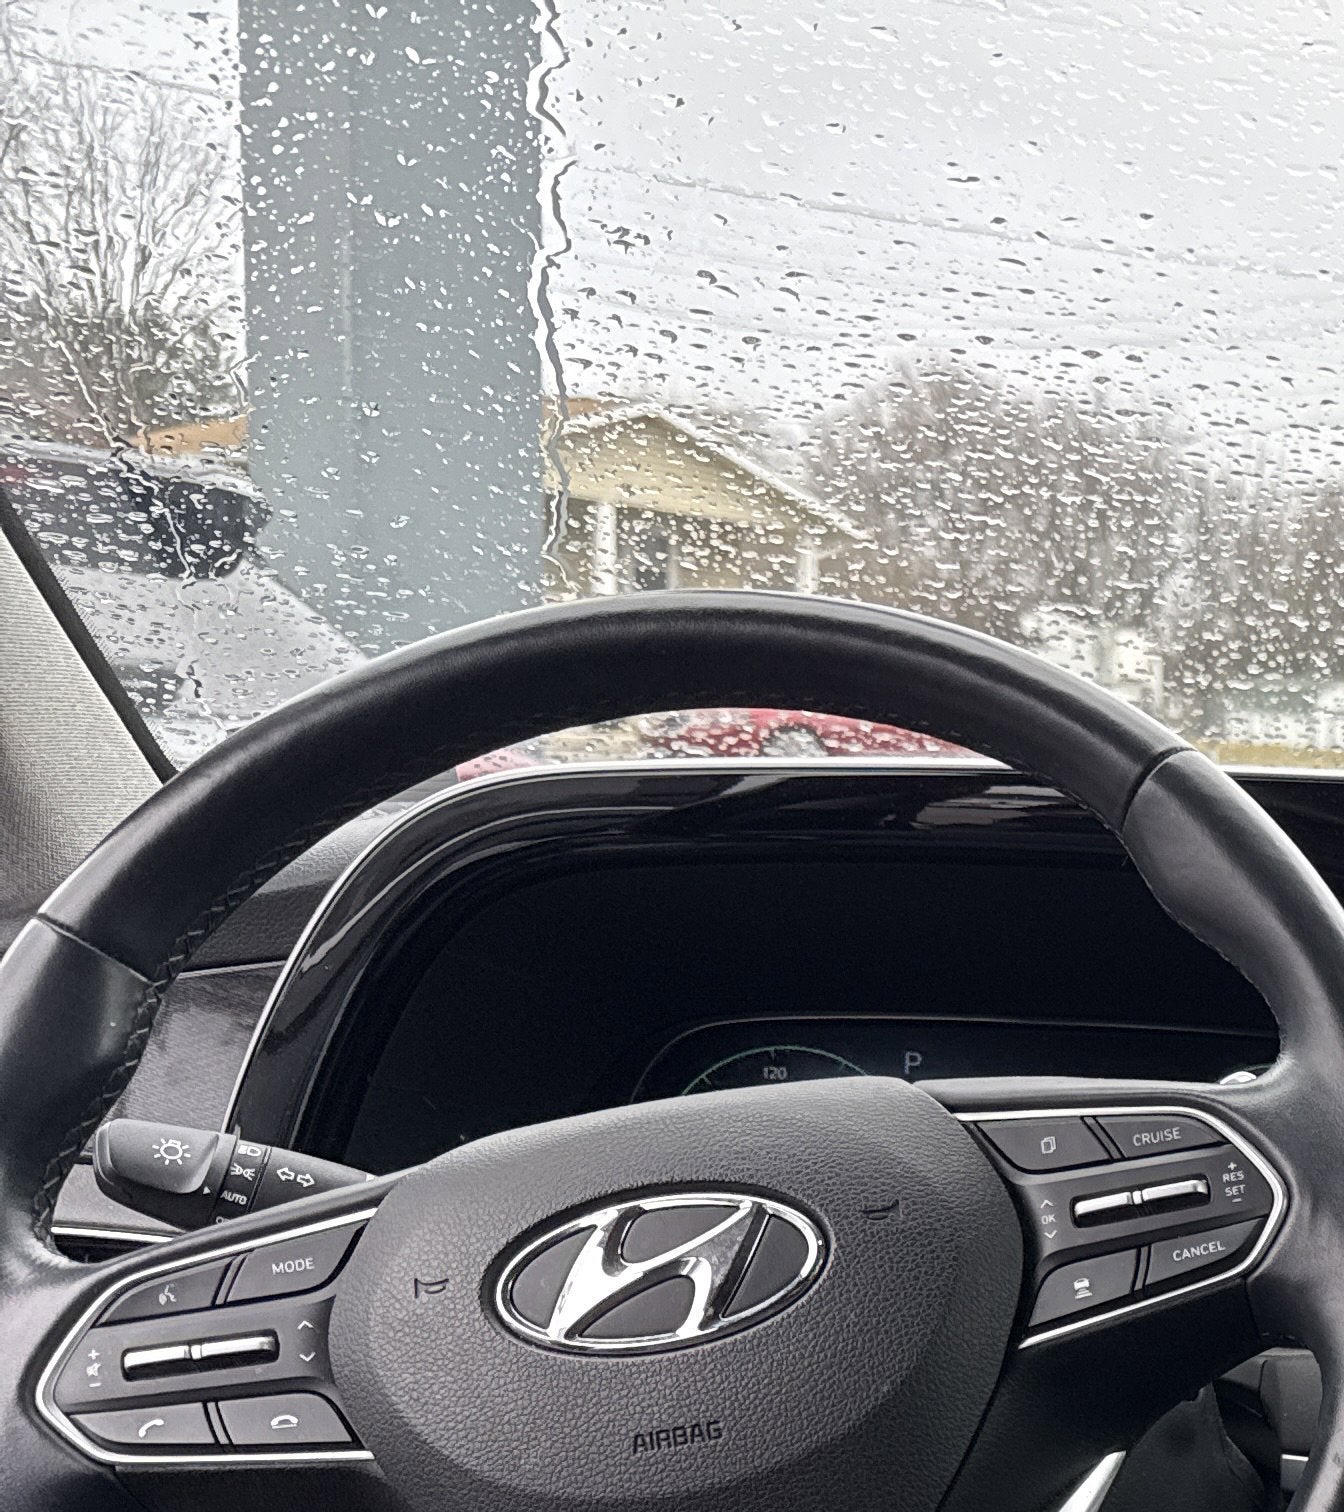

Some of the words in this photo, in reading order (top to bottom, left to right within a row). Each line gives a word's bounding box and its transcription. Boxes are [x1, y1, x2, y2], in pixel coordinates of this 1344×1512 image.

[904, 1051, 922, 1075] P
[763, 1066, 788, 1080] 120
[1132, 1126, 1182, 1147] CRUISE
[1222, 1170, 1245, 1183] RES
[220, 1189, 248, 1205] AUTO
[1224, 1184, 1246, 1196] SET
[1041, 1213, 1056, 1225] OK
[1172, 1240, 1226, 1262] CANCEL
[271, 1257, 315, 1275] MODE
[632, 1420, 723, 1454] AIRBAG
